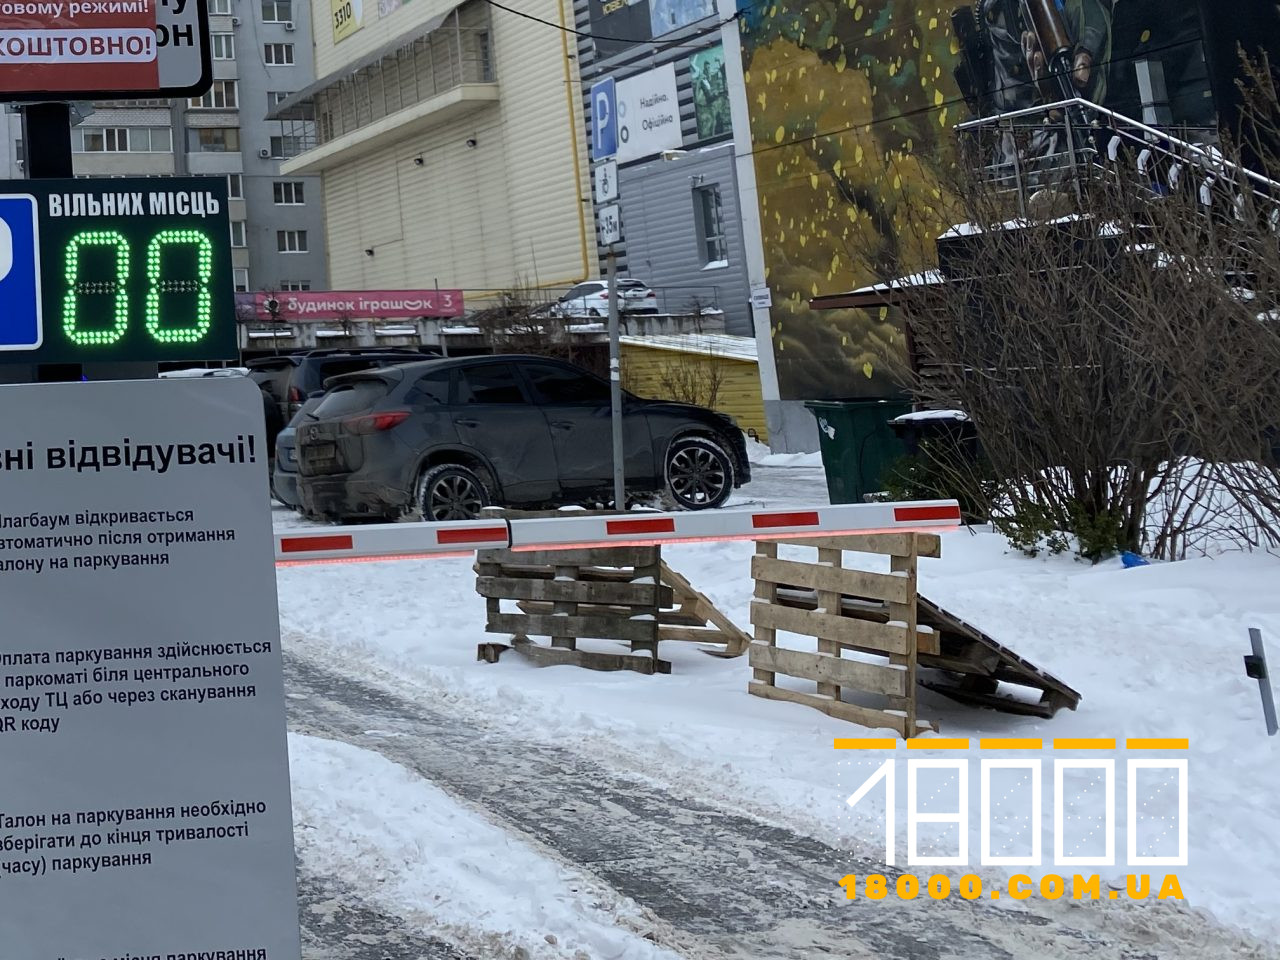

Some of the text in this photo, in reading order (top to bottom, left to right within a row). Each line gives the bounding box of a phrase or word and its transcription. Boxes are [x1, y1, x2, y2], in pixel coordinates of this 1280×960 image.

[69, 0, 149, 17] режимі!
[596, 92, 609, 149] P
[49, 191, 220, 218] ВІЛЬНИХ МІСЦЬ
[62, 230, 213, 345] 00
[288, 297, 355, 314] будинок
[443, 294, 453, 308] 3
[47, 435, 257, 474] відвідувачі!
[75, 509, 194, 527] відкривається
[98, 530, 142, 545] після
[147, 529, 235, 547] отримання
[49, 557, 69, 569] на
[73, 553, 169, 571] паркування
[55, 647, 153, 668] паркування
[157, 641, 272, 661] здійснюється
[5, 668, 88, 691] паркоматі
[92, 666, 129, 683] біля
[133, 664, 250, 683] центрального
[44, 691, 69, 710] ТЦ
[72, 689, 103, 706] або
[107, 690, 156, 707] через
[160, 685, 256, 704] сканування
[21, 717, 60, 734] коду
[51, 813, 71, 826] на
[76, 806, 175, 827] паркування
[180, 799, 267, 818] необхідно
[79, 833, 102, 849] до
[107, 828, 151, 845] кінця
[155, 820, 249, 845] тривалості
[52, 852, 152, 874] паркування
